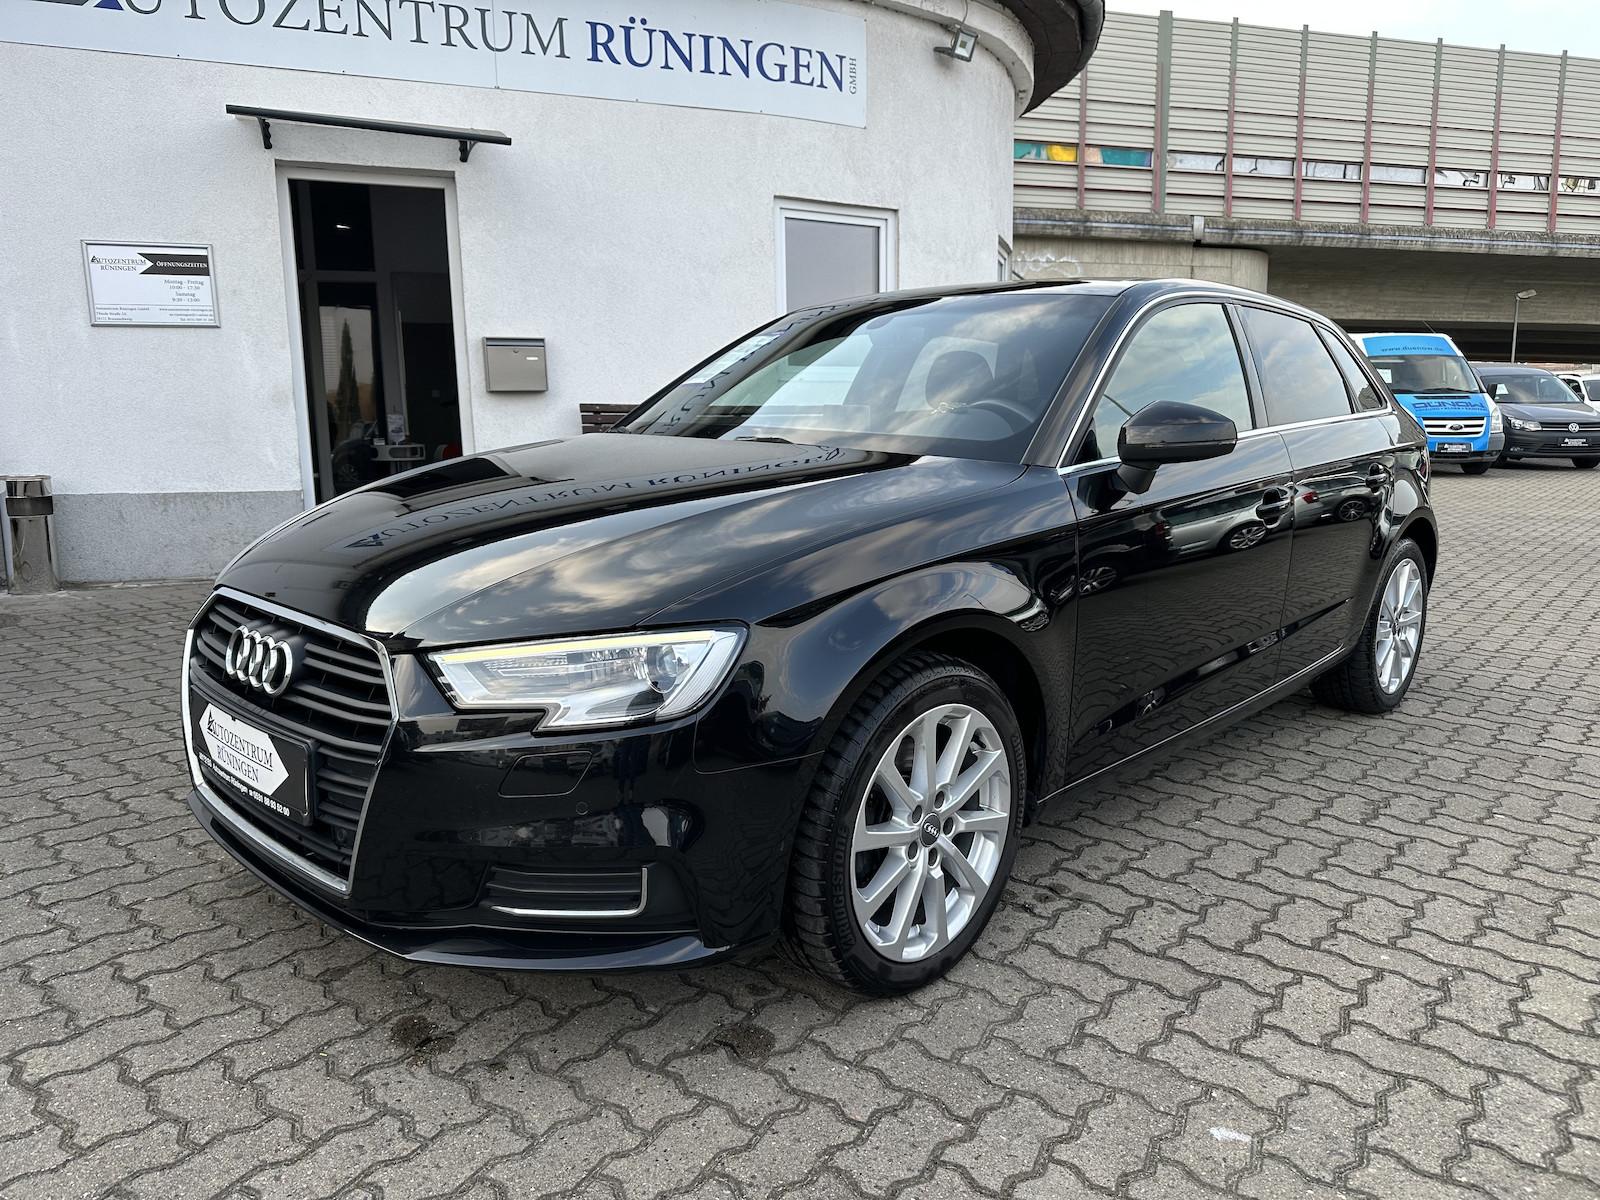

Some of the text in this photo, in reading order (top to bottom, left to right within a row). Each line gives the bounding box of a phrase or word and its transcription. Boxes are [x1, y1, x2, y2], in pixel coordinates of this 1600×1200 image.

[32, 0, 848, 93] OZENTRUM RÜNINGEN
[848, 57, 858, 95] GMBH
[90, 255, 147, 265] AUTOZENTRUM
[156, 260, 208, 268] ÖFFNUNGSZEITEN
[206, 708, 273, 768] AUTOZENTRUM
[216, 743, 259, 783] RÜNINGEN
[831, 825, 857, 947] BRIDGESTONE
